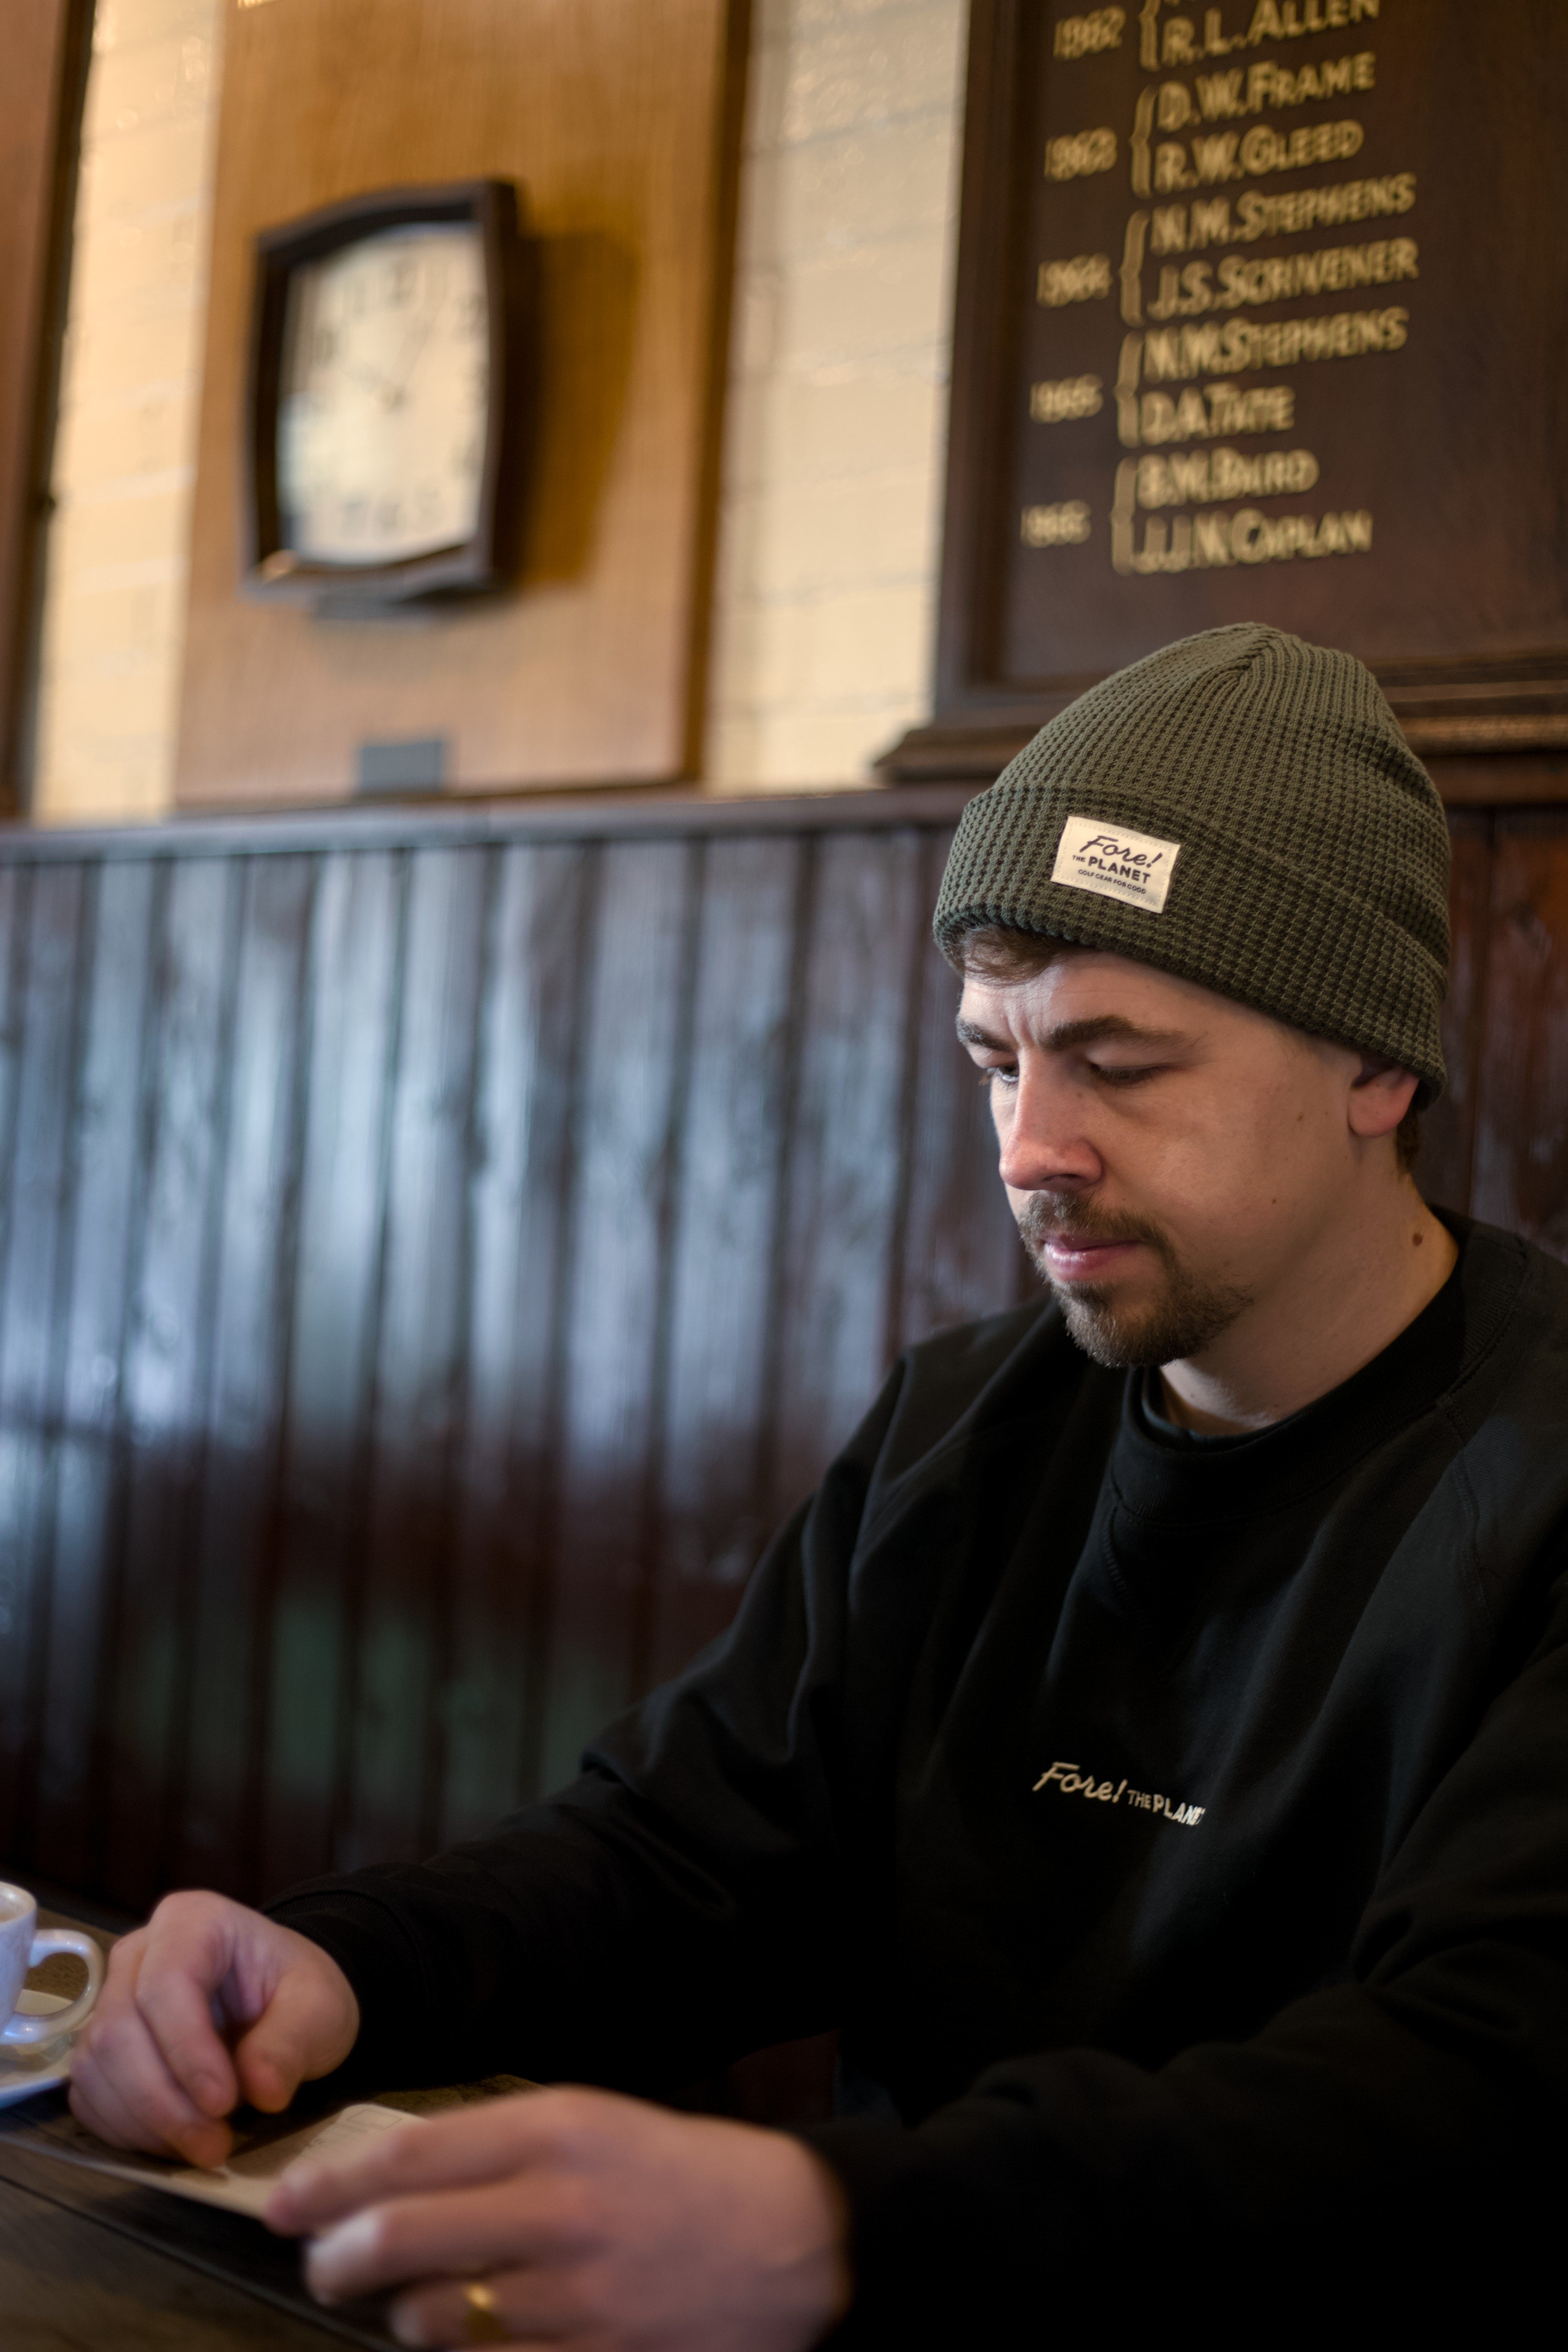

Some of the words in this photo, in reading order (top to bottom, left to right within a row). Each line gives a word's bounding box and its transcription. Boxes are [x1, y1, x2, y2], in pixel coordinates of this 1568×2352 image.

[1079, 835, 1163, 869] Fore!
[1078, 869, 1095, 878] GOLF
[1096, 873, 1113, 883] GEAR
[1113, 879, 1126, 887] FOR
[1127, 884, 1146, 894] GOOD
[1088, 855, 1151, 884] PLANET
[1032, 1761, 1128, 1804] Fore!
[1127, 1789, 1152, 1809] THE
